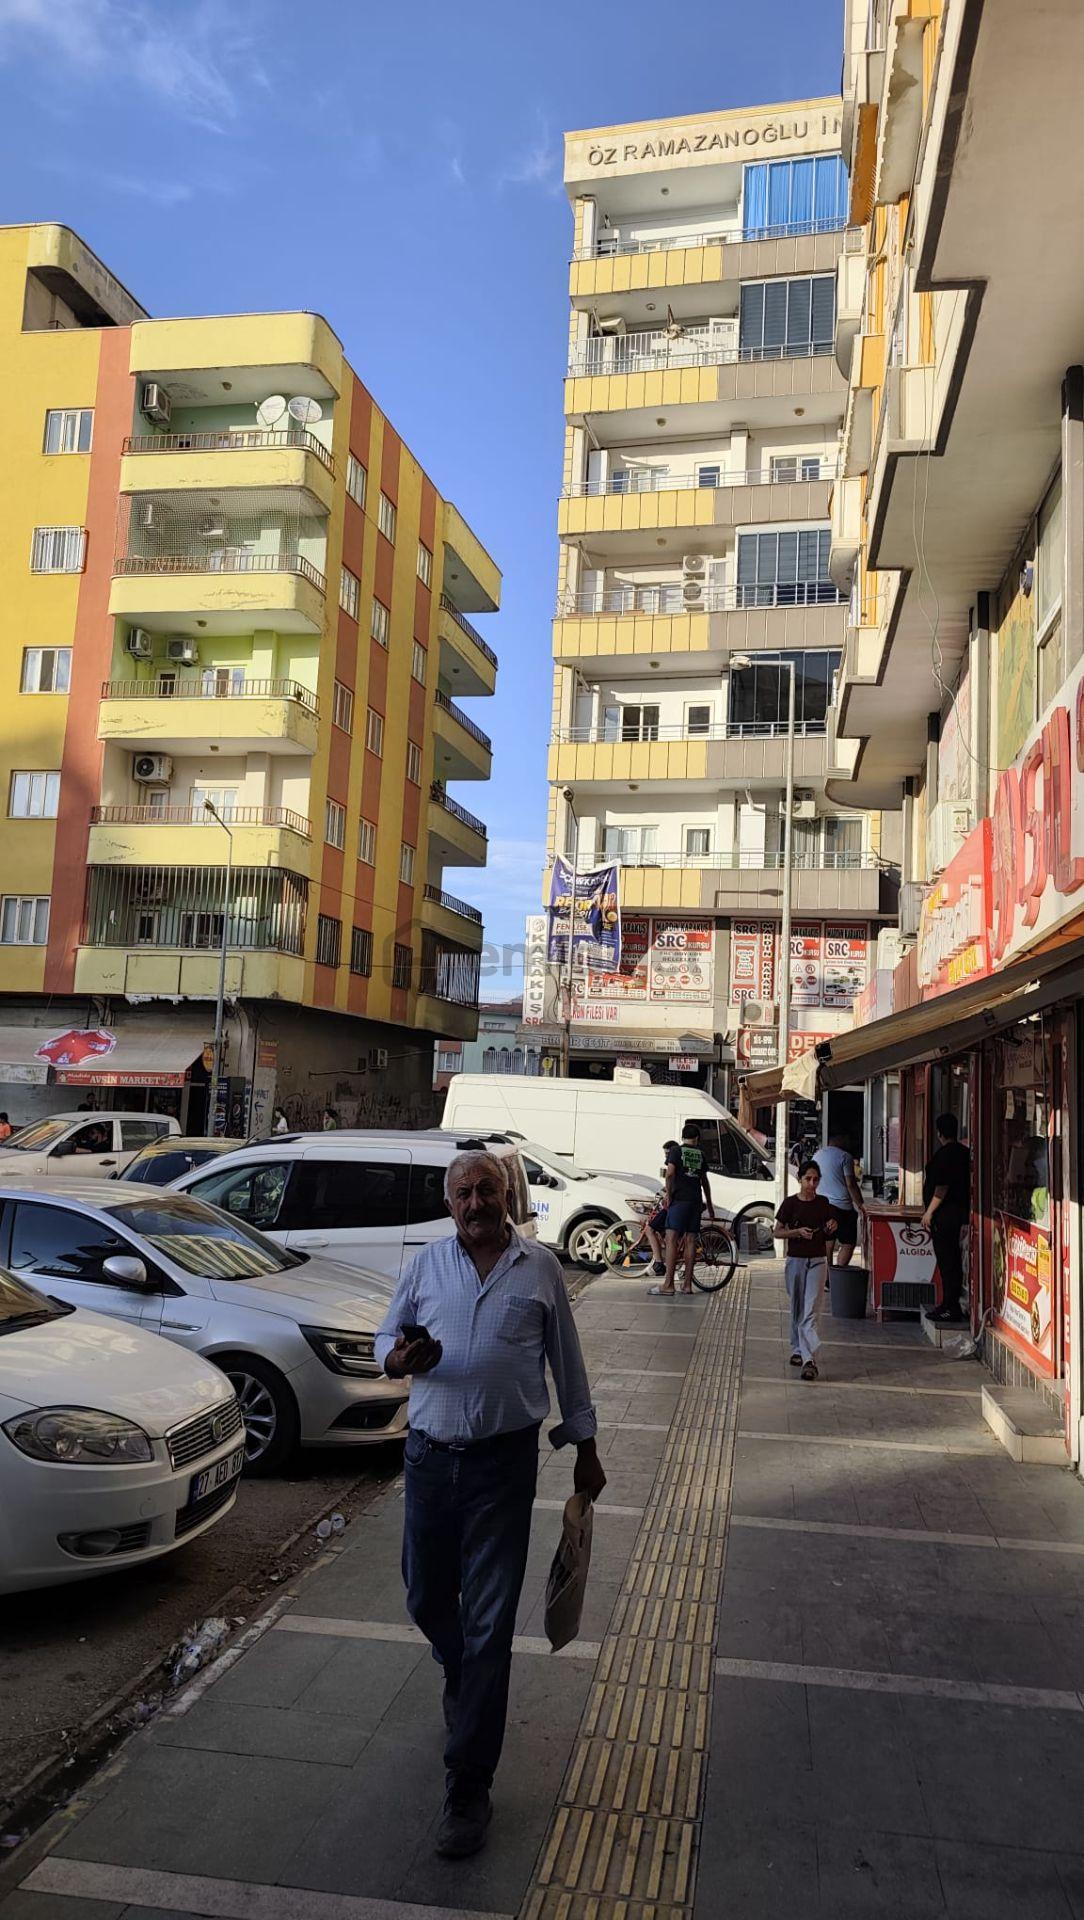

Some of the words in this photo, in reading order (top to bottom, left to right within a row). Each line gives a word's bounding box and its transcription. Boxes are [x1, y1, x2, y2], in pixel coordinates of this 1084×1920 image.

[588, 145, 617, 167] ÖZ
[623, 121, 807, 161] RAMAZANOĞLU
[736, 924, 756, 934] SRC
[656, 935, 686, 948] SRC
[687, 942, 710, 950] KURSU
[789, 942, 802, 954] RC
[828, 942, 848, 956] SRC
[529, 933, 545, 1015] KARAKUŞ
[734, 989, 755, 1000] SRC
[120, 1076, 160, 1085] MARKET
[900, 1248, 932, 1256] ALGIDA
[199, 1471, 210, 1495] 27
